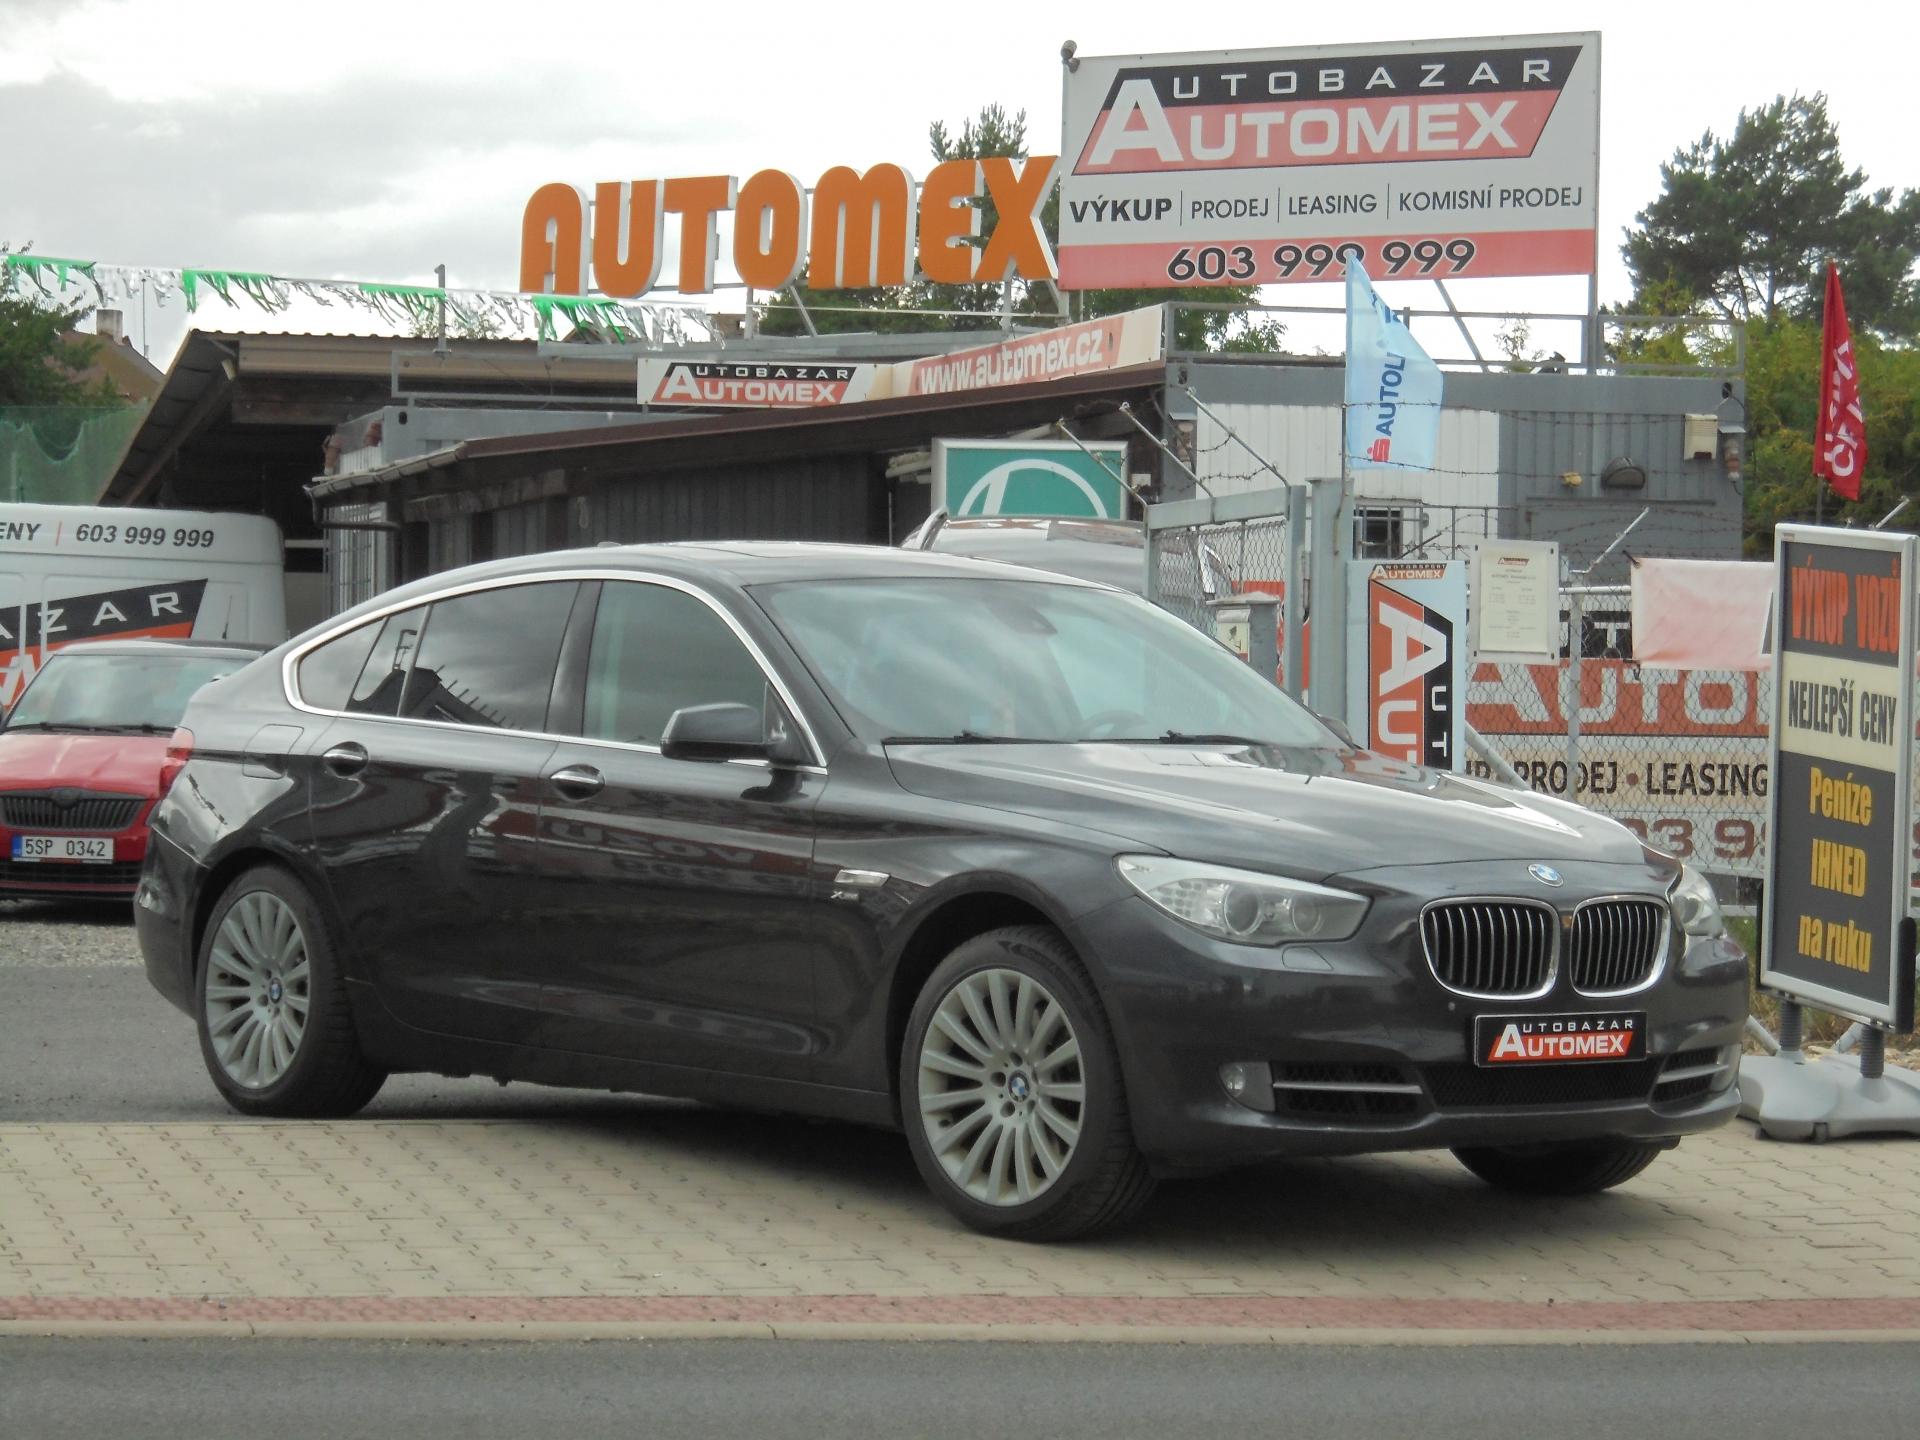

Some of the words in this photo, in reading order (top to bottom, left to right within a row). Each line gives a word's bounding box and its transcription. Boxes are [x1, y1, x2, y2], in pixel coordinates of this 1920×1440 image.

[1088, 79, 1518, 165] AUTOMEX
[519, 155, 1060, 297] AUTOMEX
[1070, 195, 1172, 223] VÝKUP
[1191, 198, 1269, 219] PRODEJ
[1289, 194, 1377, 215] LEASING
[1400, 184, 1494, 211] KOMISNÍ
[1500, 187, 1582, 208] PRODEJ
[1167, 246, 1256, 281] 603
[1274, 243, 1365, 278] 999
[1382, 239, 1475, 275] 999
[661, 366, 836, 403] AUTOMEX
[921, 329, 1103, 394] www.automex.cz
[76, 524, 117, 543] 603
[124, 527, 166, 545] 999
[173, 529, 214, 547] 999
[1371, 564, 1441, 579] AUTOMEX
[1791, 554, 1848, 645] VÝKUP
[1788, 678, 1855, 737] NEJLEPŠÍ
[1860, 691, 1896, 746] CENY
[1647, 762, 1768, 797] LEASING
[1810, 766, 1872, 826] Peníze
[25, 839, 53, 855] 5SP
[66, 840, 105, 857] 0342
[1810, 838, 1866, 898] IHNED
[1798, 915, 1822, 959] na
[1825, 919, 1871, 973] ruku
[1494, 1024, 1624, 1057] AUTOMEX
